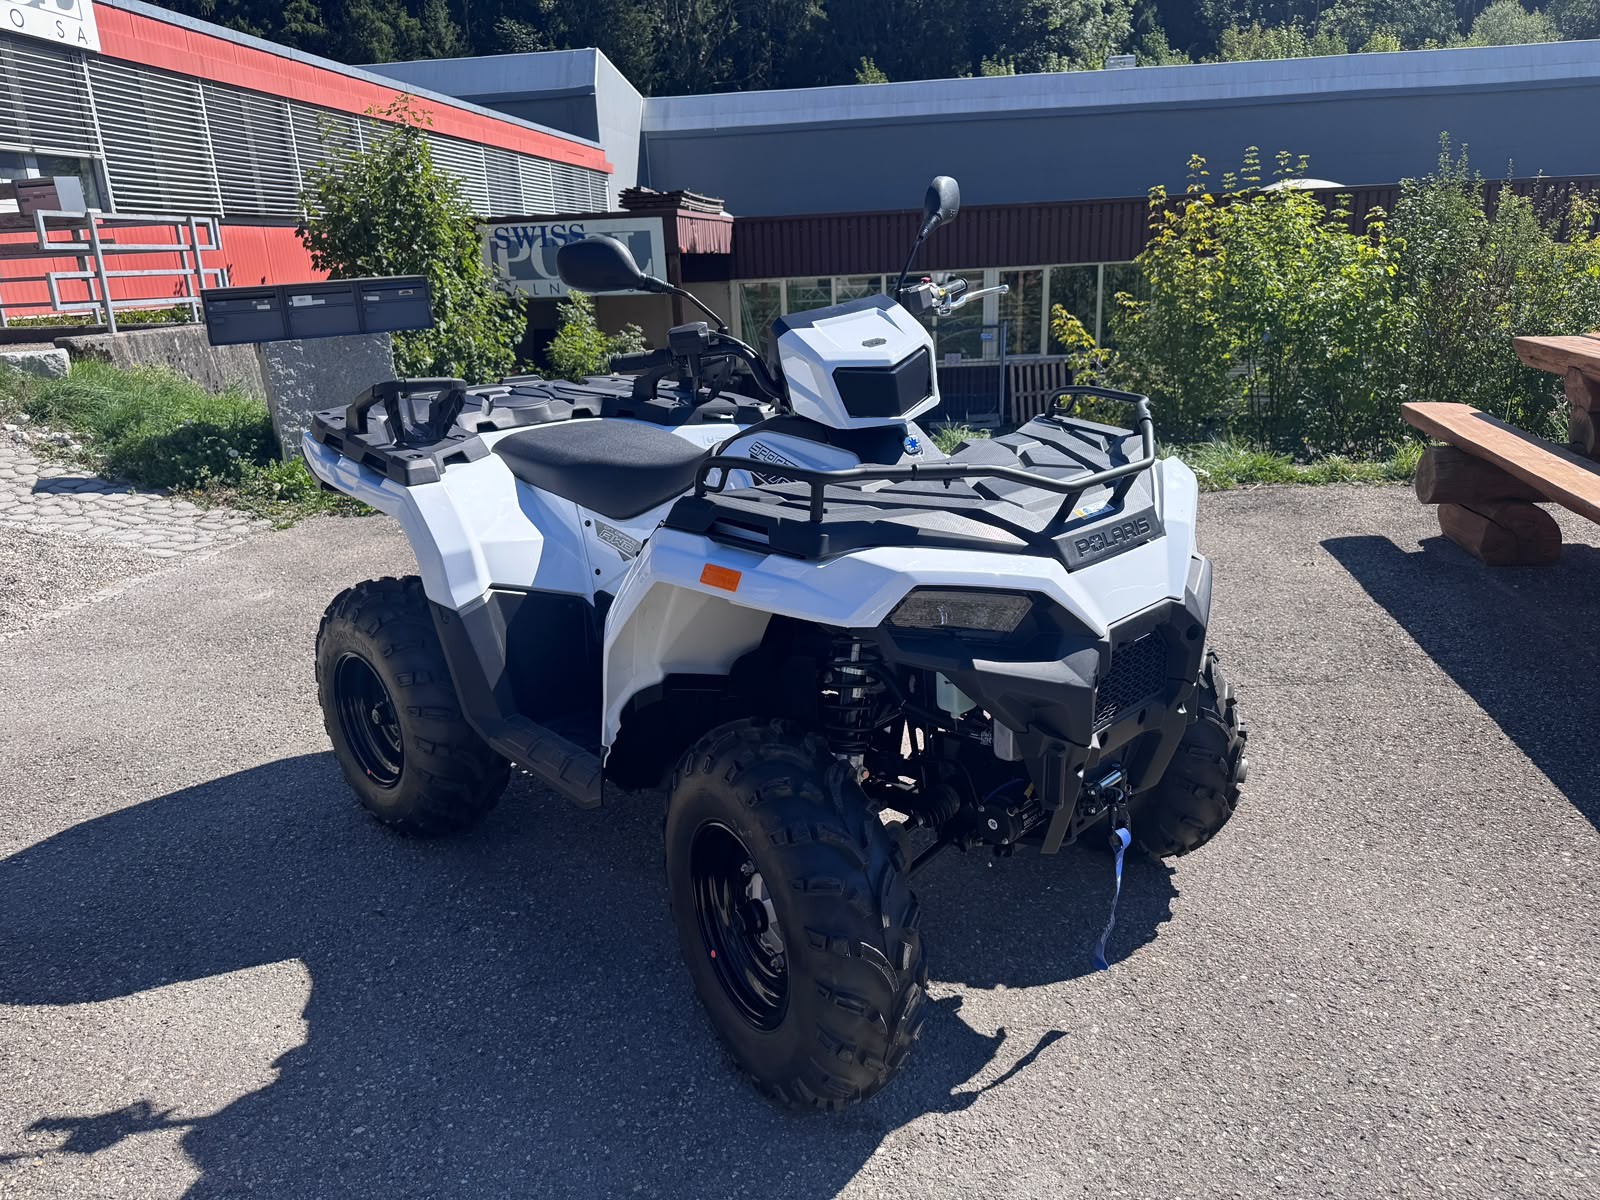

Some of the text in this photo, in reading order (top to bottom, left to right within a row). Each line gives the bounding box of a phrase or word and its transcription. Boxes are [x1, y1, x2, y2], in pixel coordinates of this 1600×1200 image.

[494, 223, 585, 250] SWISS
[598, 529, 634, 553] AWD
[1074, 516, 1151, 558] POLARIS
